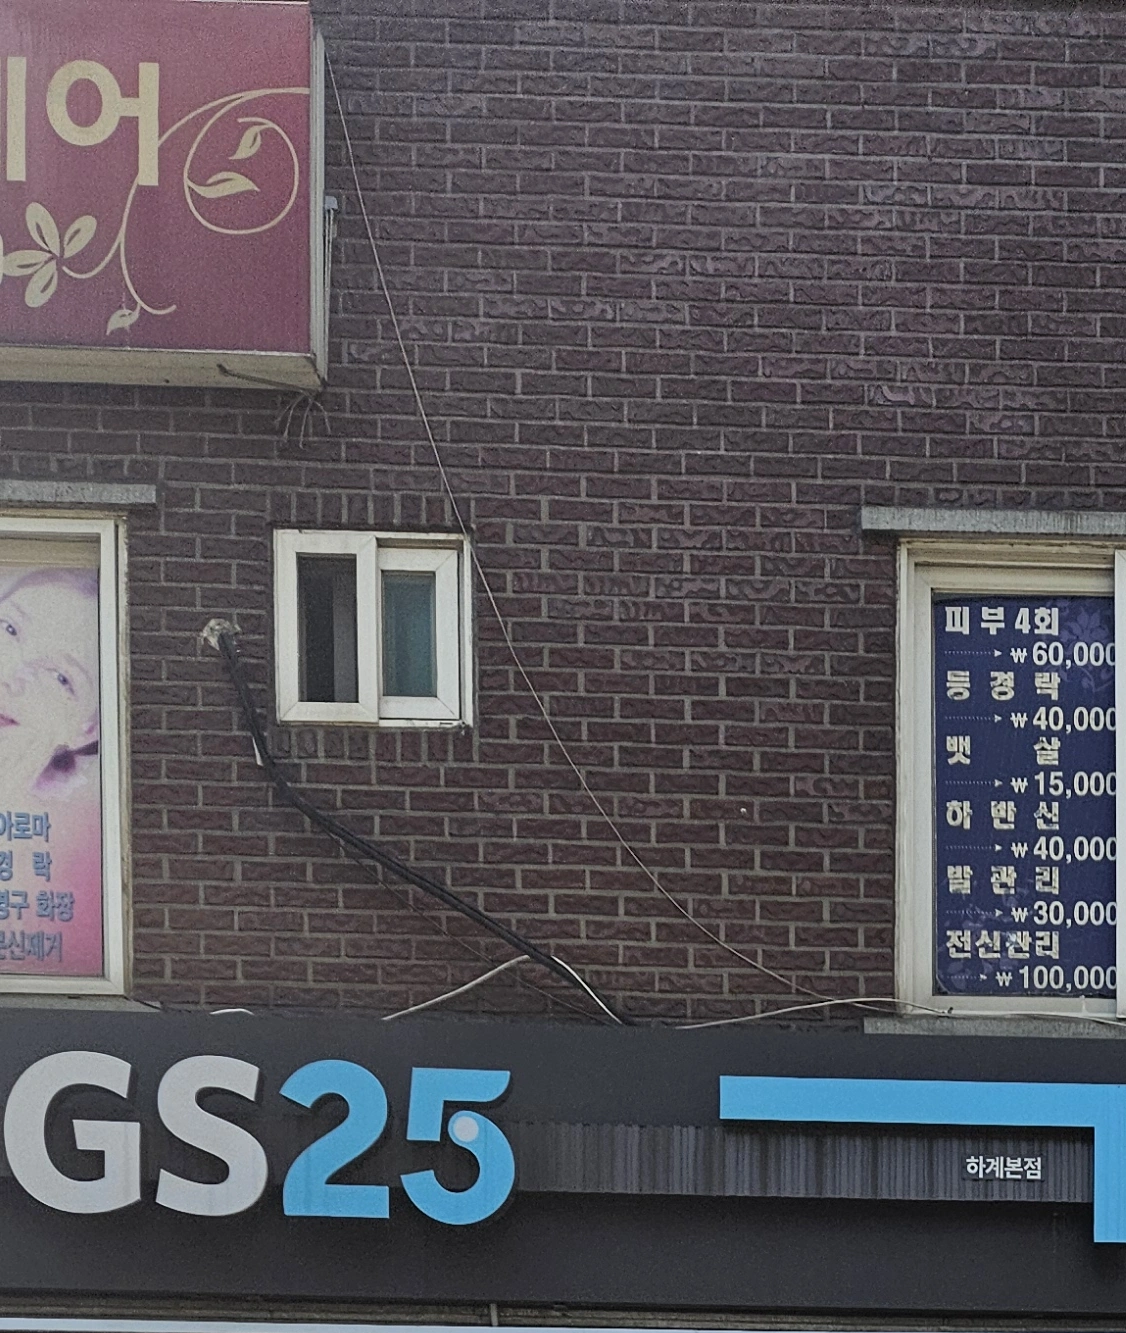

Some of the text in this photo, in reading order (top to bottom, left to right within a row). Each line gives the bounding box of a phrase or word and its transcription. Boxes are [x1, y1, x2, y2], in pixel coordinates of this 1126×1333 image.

[0, 811, 52, 843] 아로마
[946, 930, 1060, 960] 전신관리
[3, 1050, 516, 1226] GS25
[965, 1155, 1042, 1180] 하계본점
